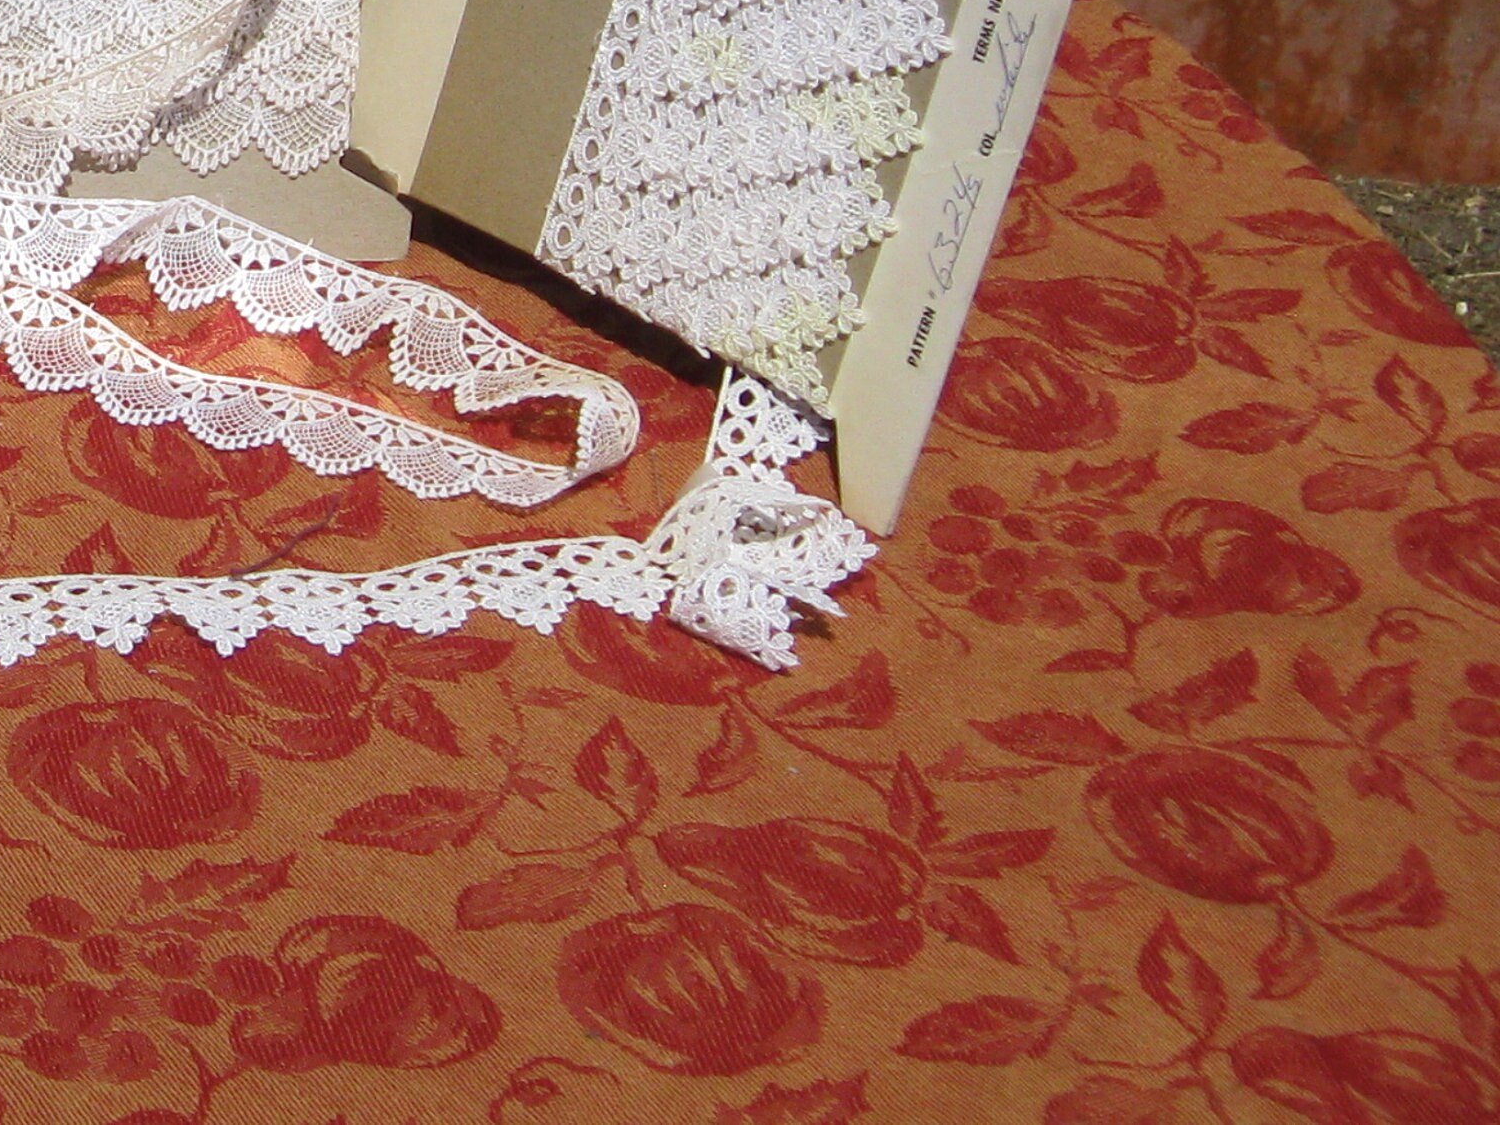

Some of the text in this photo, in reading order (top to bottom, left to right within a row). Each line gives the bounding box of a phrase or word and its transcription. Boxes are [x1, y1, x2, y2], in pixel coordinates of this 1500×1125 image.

[973, 20, 995, 62] TERMS
[908, 307, 935, 367] PATTERN
[980, 134, 996, 156] COL
